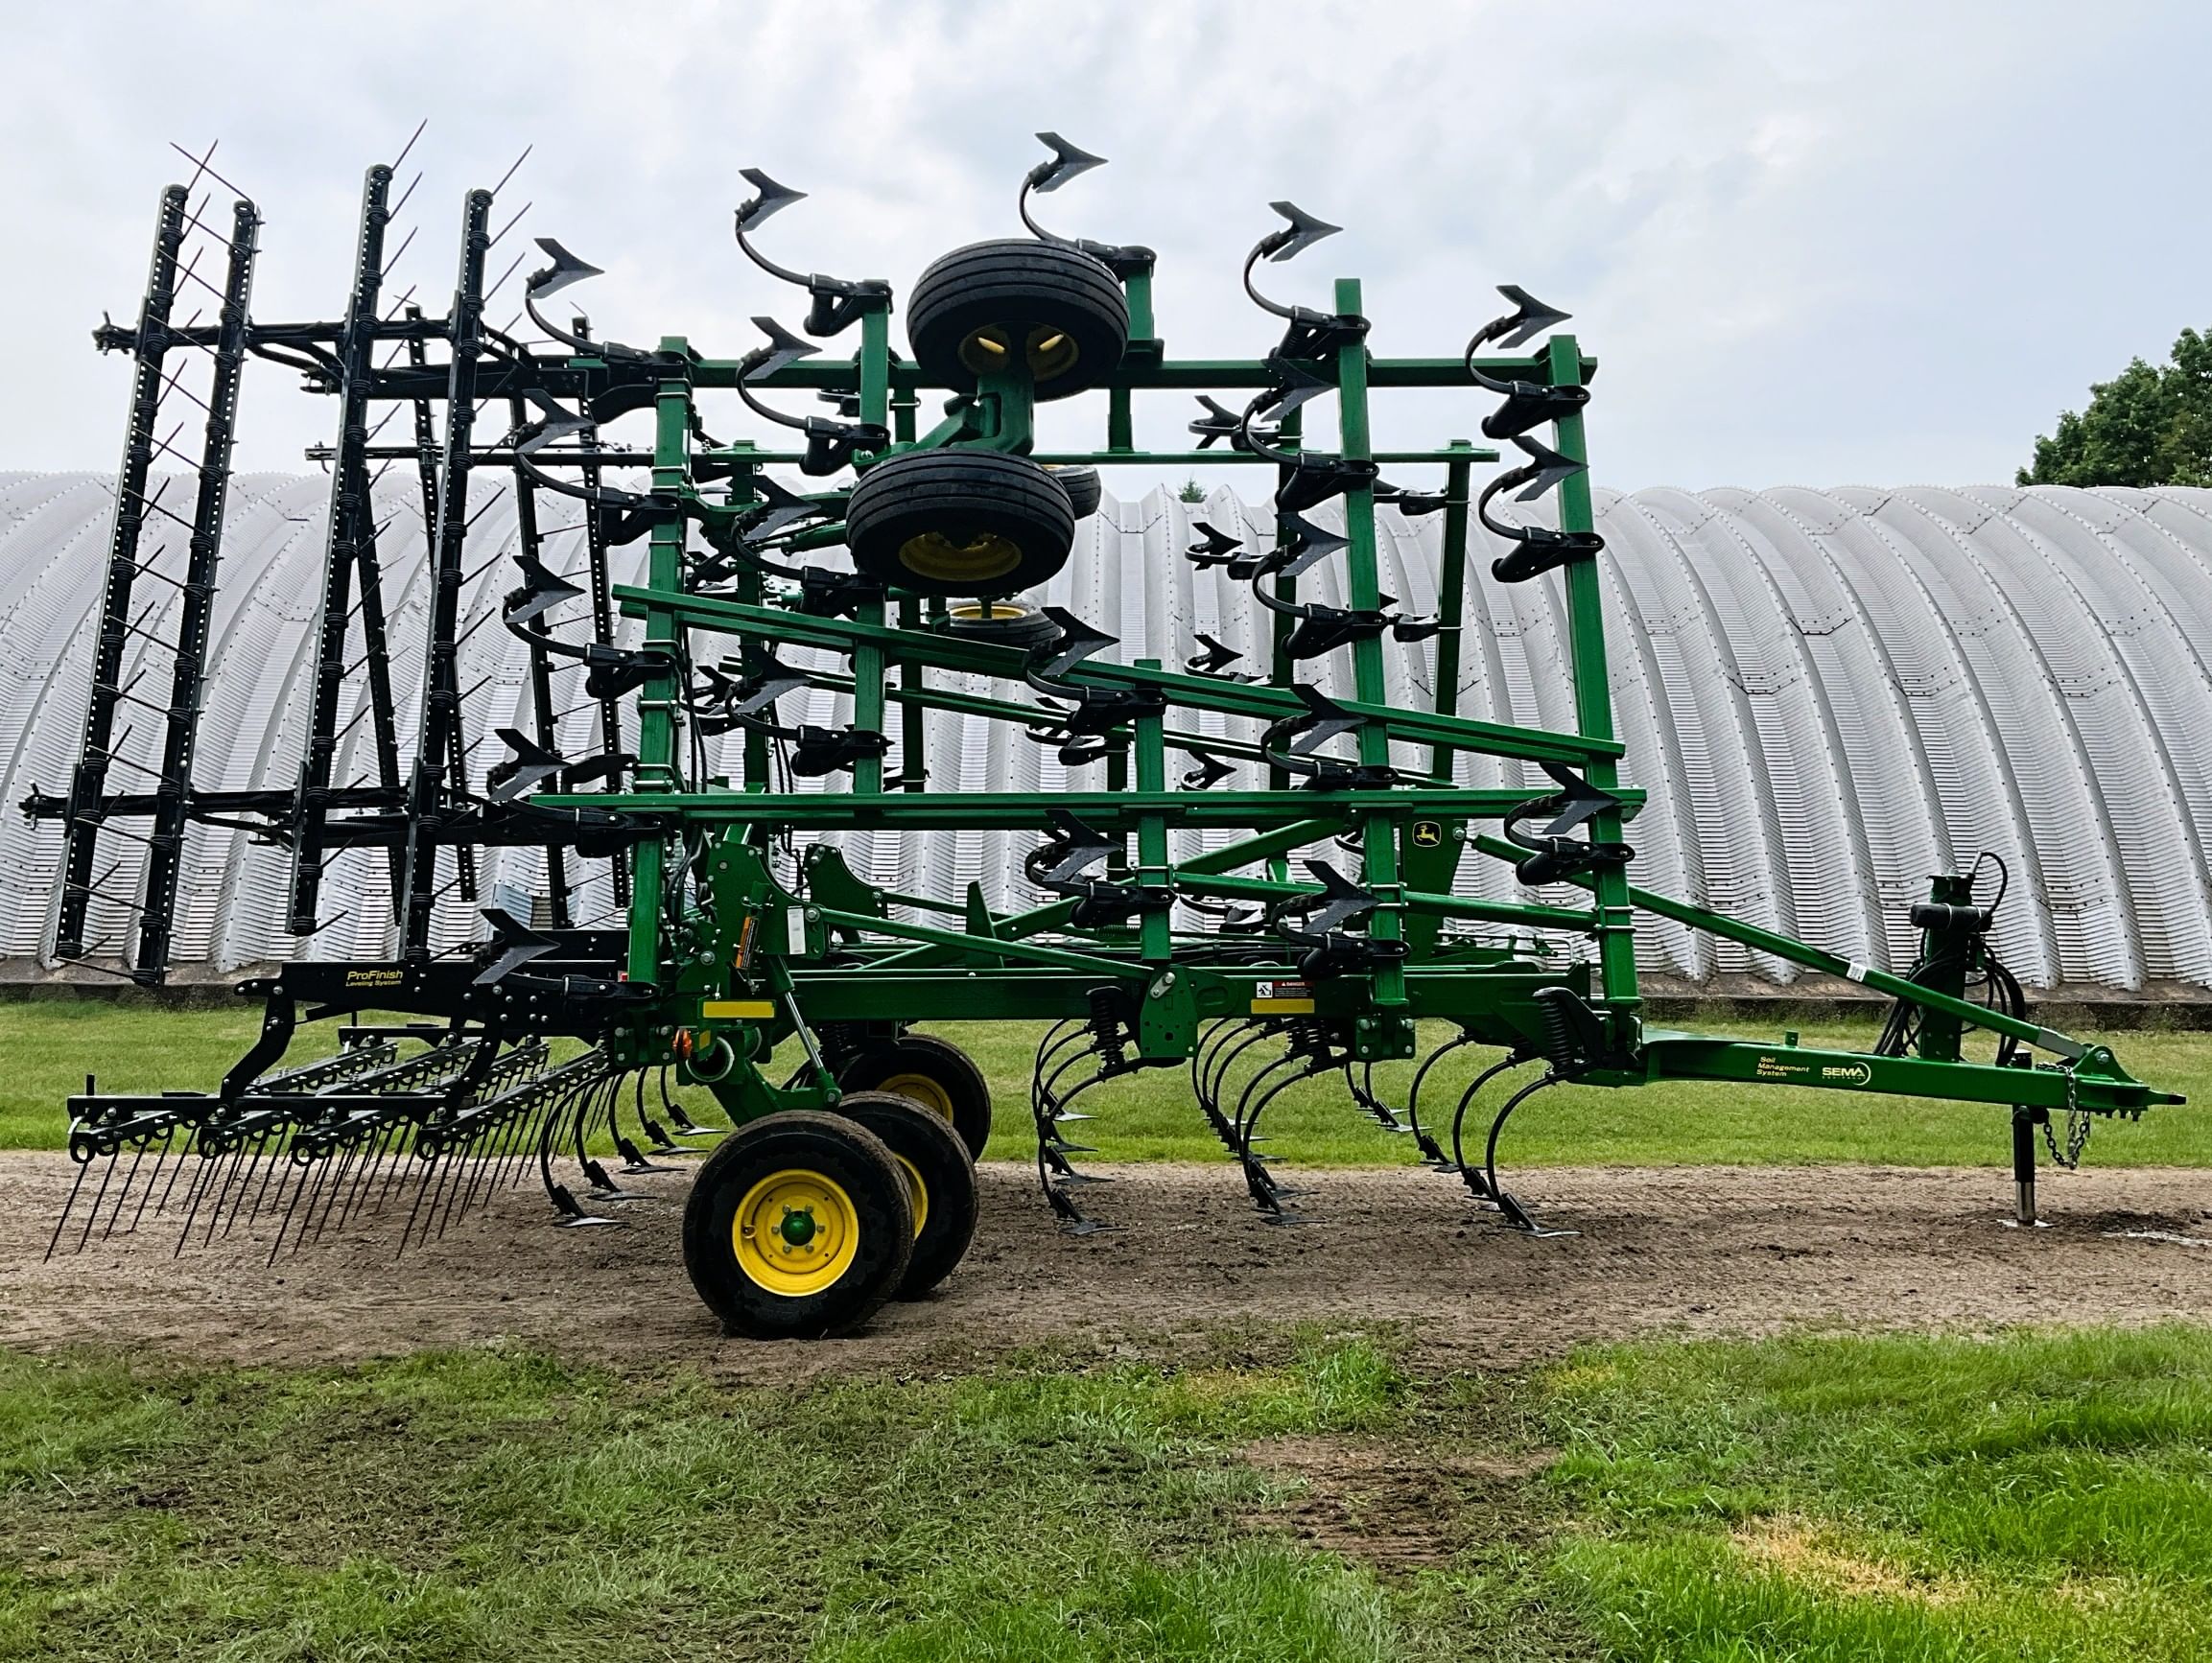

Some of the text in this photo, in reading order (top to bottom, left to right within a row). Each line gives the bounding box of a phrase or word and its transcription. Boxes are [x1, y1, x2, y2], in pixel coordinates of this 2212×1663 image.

[347, 970, 403, 980] ProFinish
[1756, 1068, 1787, 1077] System
[1757, 1063, 1810, 1073] Management
[1823, 1066, 1866, 1077] SEMA
